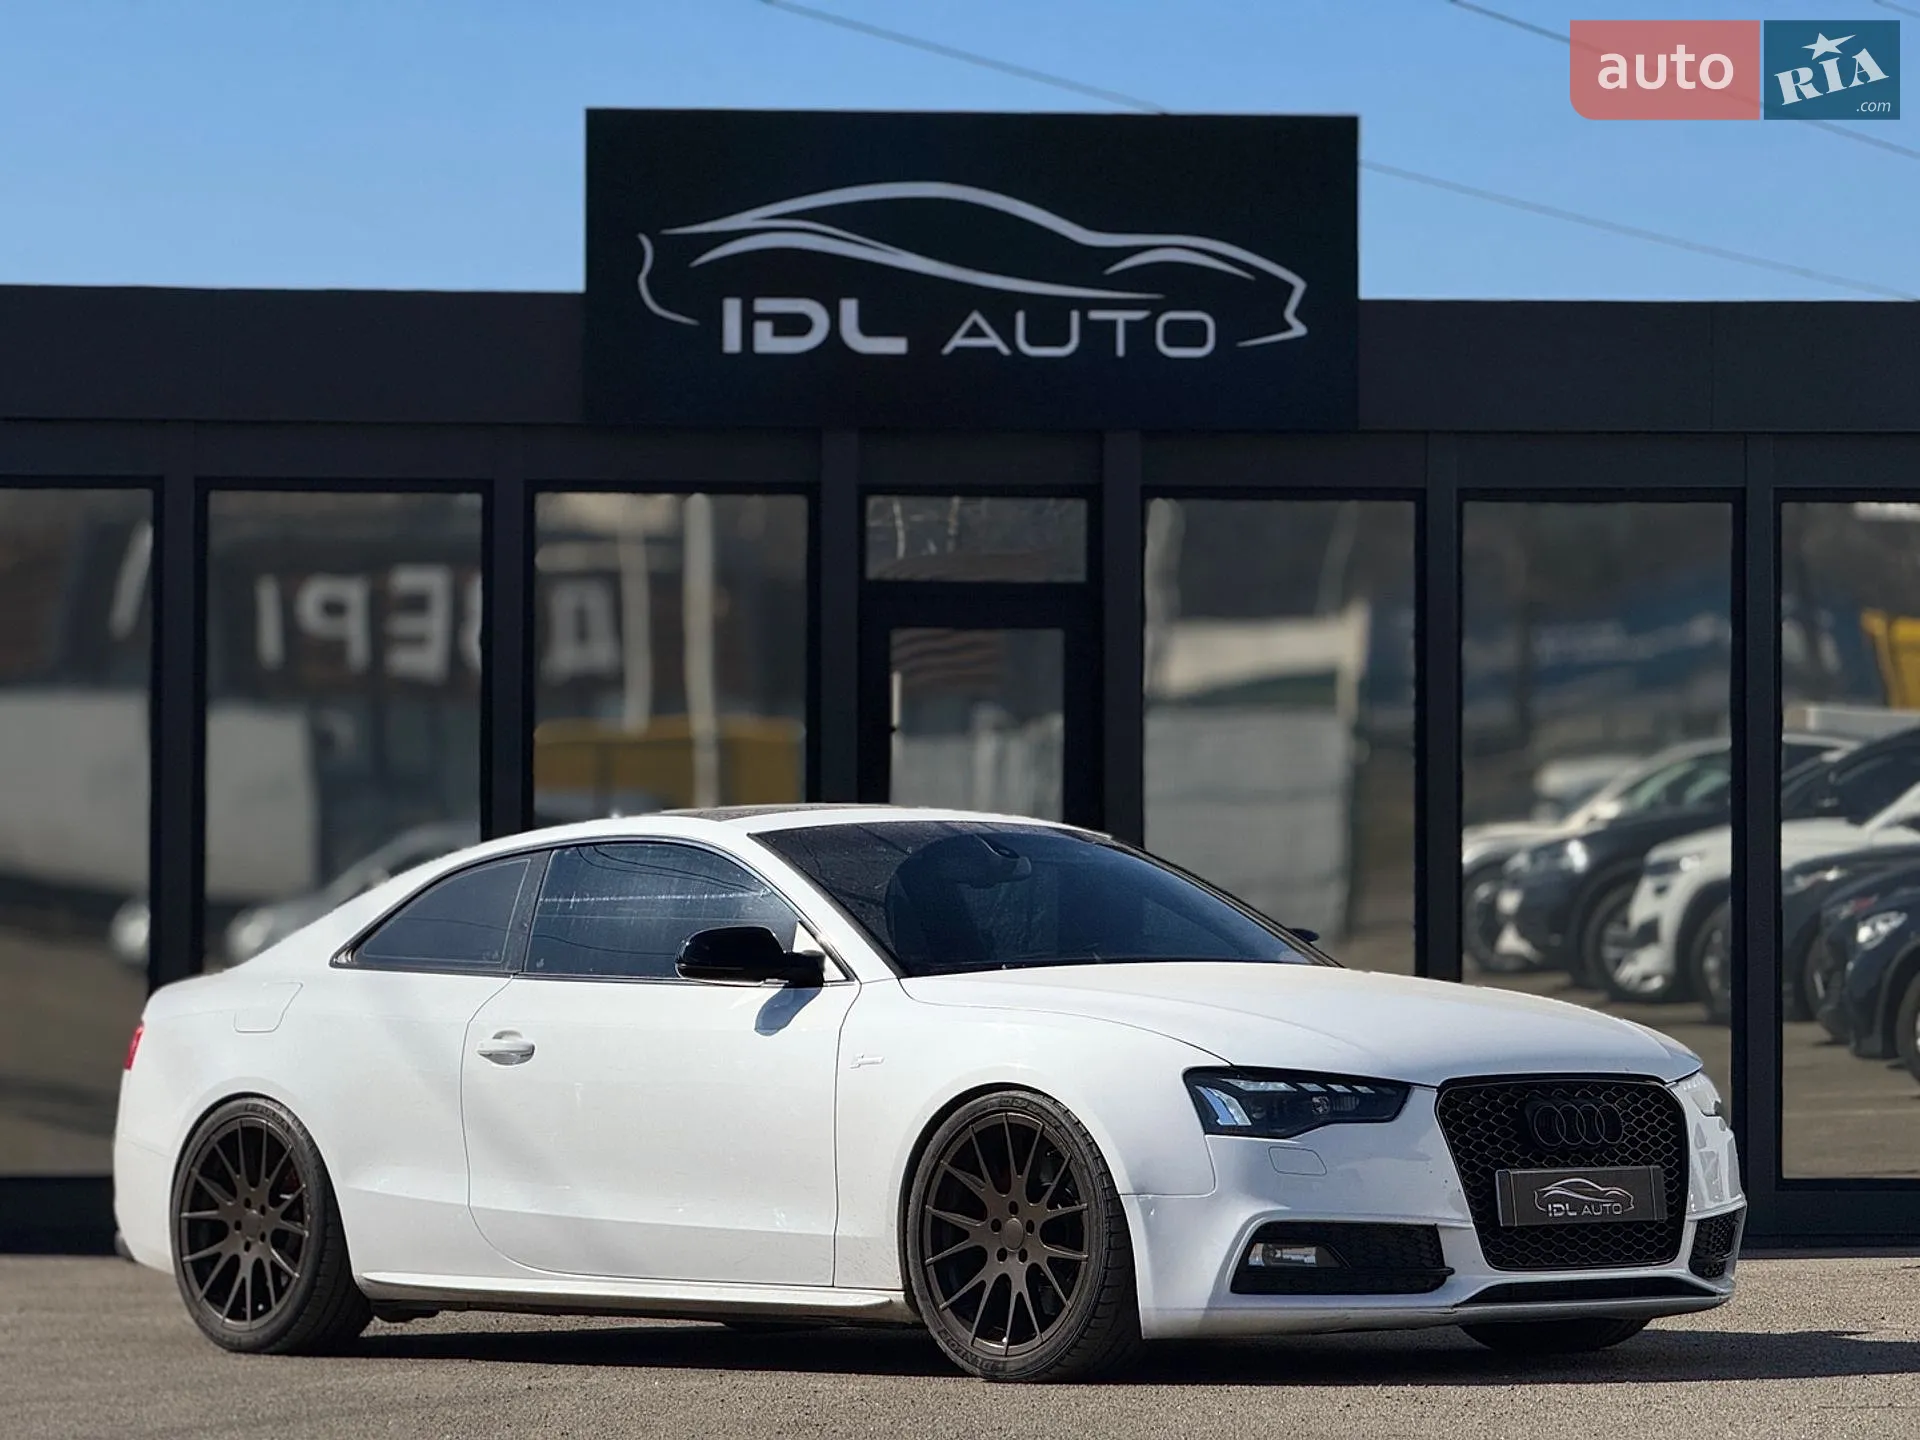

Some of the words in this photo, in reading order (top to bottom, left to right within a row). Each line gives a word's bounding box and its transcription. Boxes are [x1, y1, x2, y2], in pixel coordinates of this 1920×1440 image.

[722, 296, 908, 355] IDL
[941, 309, 1217, 358] AUTO
[1547, 1202, 1577, 1217] IDL
[1581, 1202, 1623, 1216] AUTO
